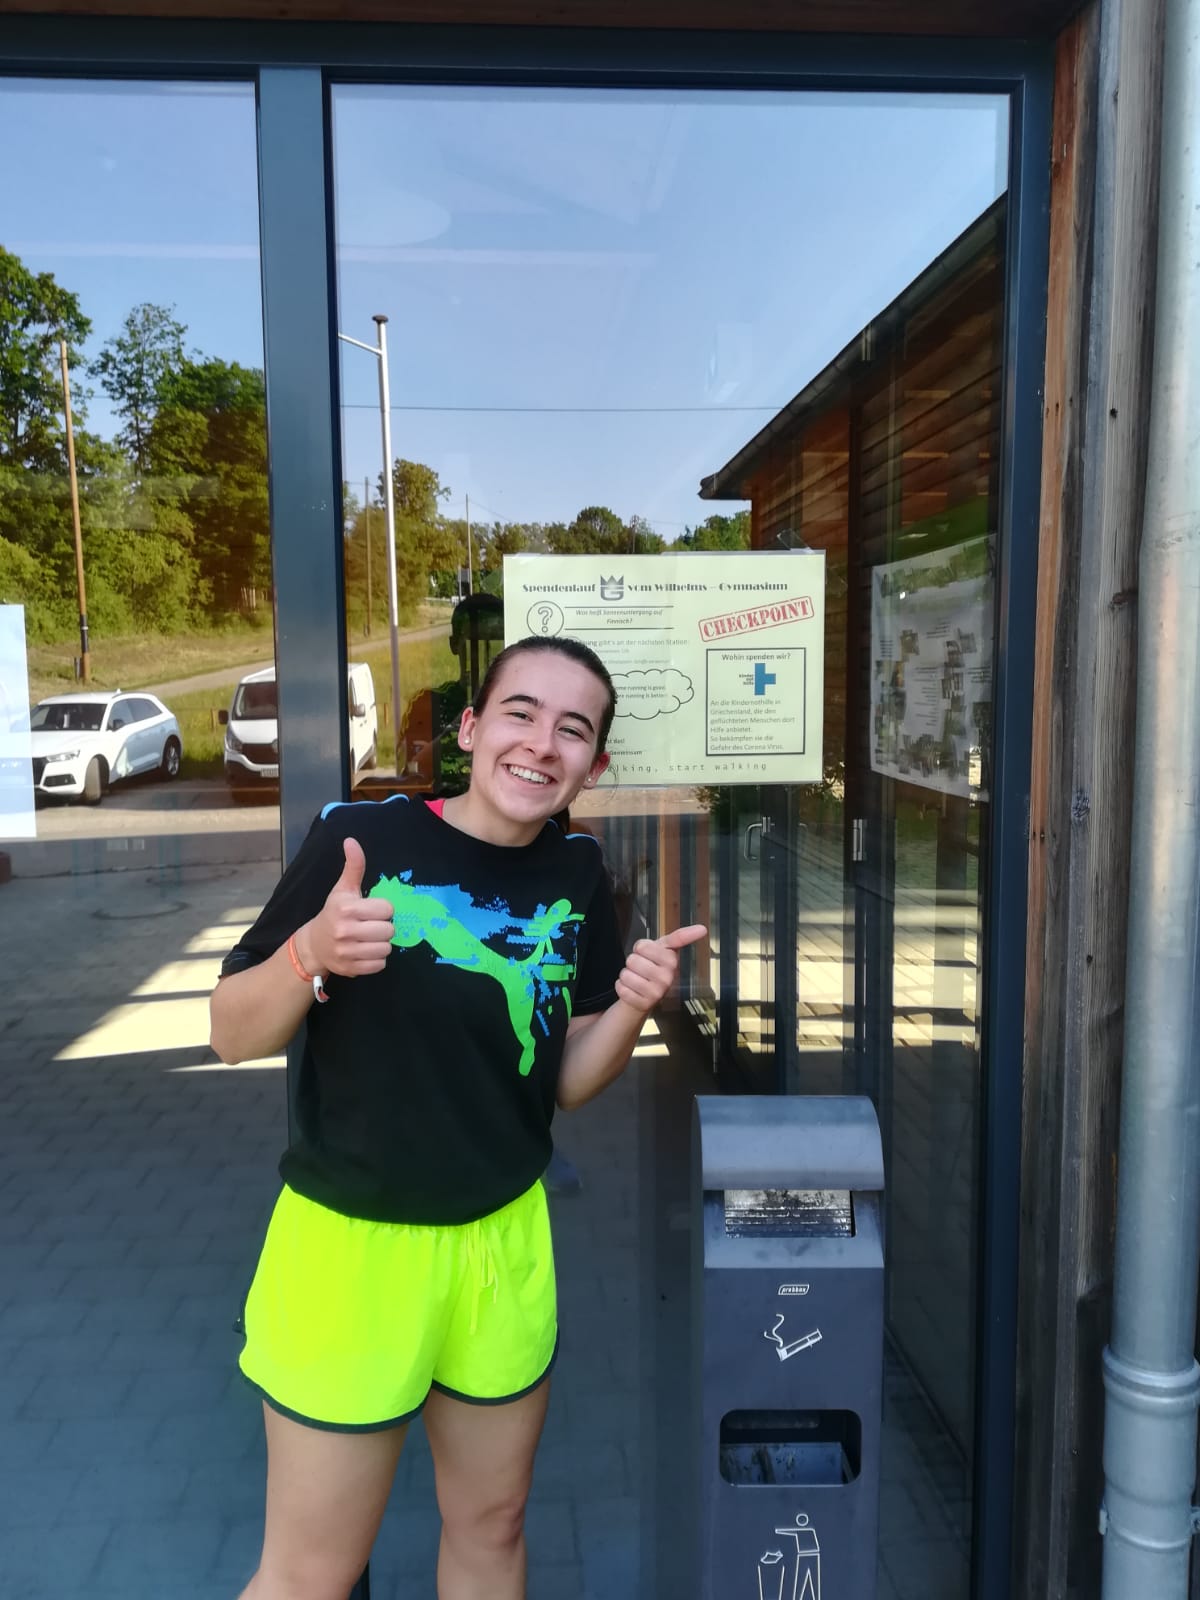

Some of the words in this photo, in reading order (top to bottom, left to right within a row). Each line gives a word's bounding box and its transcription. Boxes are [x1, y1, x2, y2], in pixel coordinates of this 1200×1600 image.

[522, 584, 596, 593] Spendenlauf
[628, 584, 652, 592] vom
[655, 583, 707, 592] Wilhelms
[719, 581, 788, 591] Gymnasium
[703, 600, 809, 638] CHECKPOINT
[746, 654, 774, 663] spenden
[776, 653, 791, 661] wir?
[744, 743, 766, 751] Corona
[715, 761, 767, 771] walking
